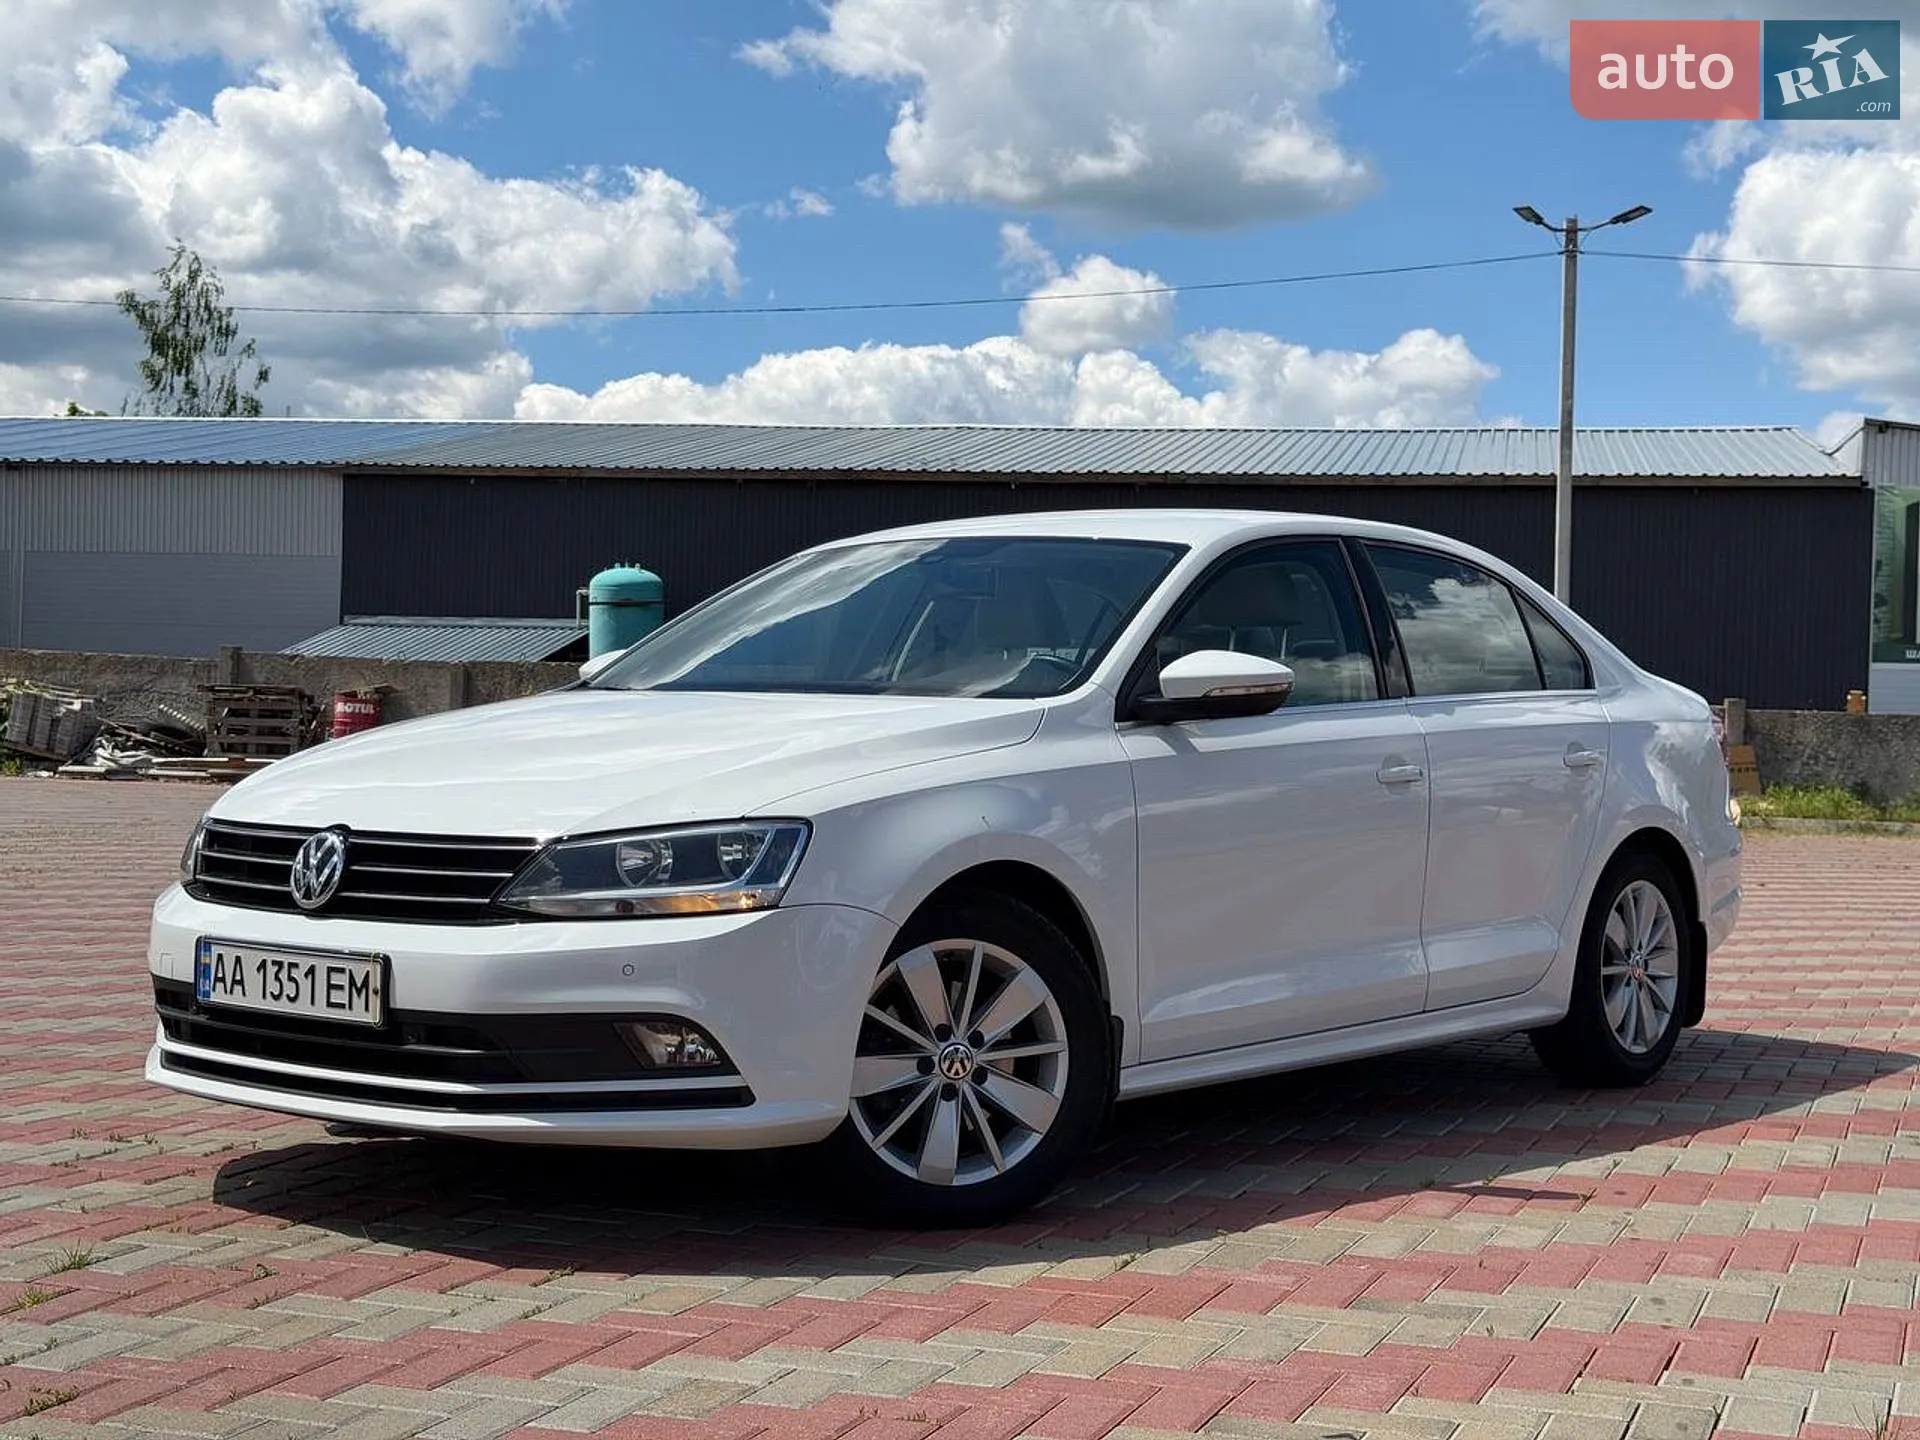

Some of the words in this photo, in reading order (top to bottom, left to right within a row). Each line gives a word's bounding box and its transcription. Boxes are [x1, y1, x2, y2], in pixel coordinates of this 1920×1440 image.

[212, 953, 247, 997] AA
[256, 959, 316, 1006] 1351
[326, 965, 370, 1013] EM
